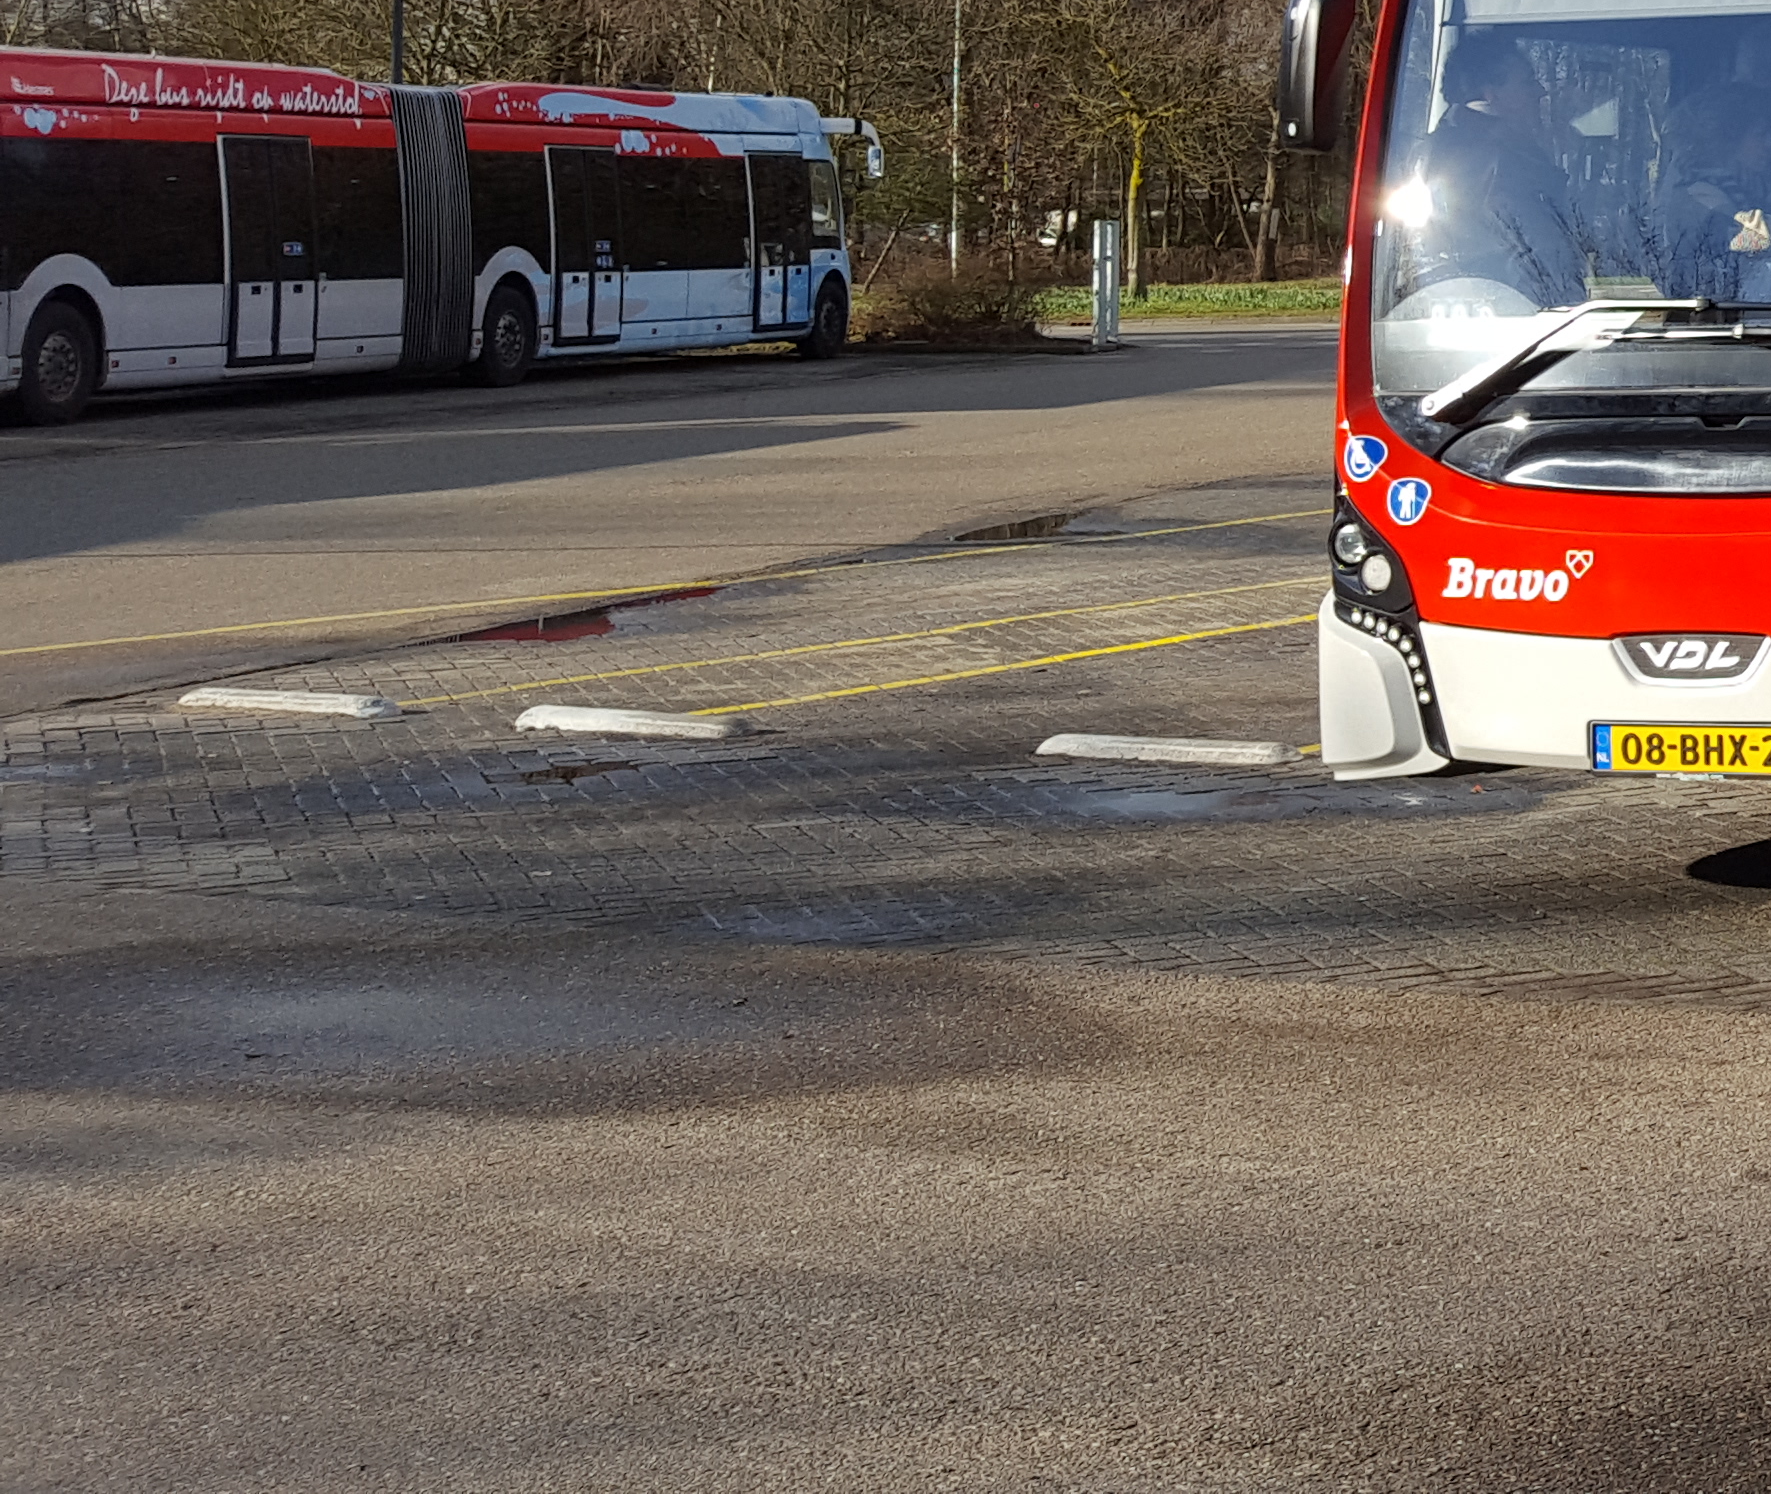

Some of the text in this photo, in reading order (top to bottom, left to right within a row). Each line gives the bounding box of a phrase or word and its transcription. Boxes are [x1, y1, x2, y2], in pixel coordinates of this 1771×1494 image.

[155, 67, 190, 106] bus
[1442, 557, 1570, 602] Bravo
[1638, 640, 1742, 670] VDL
